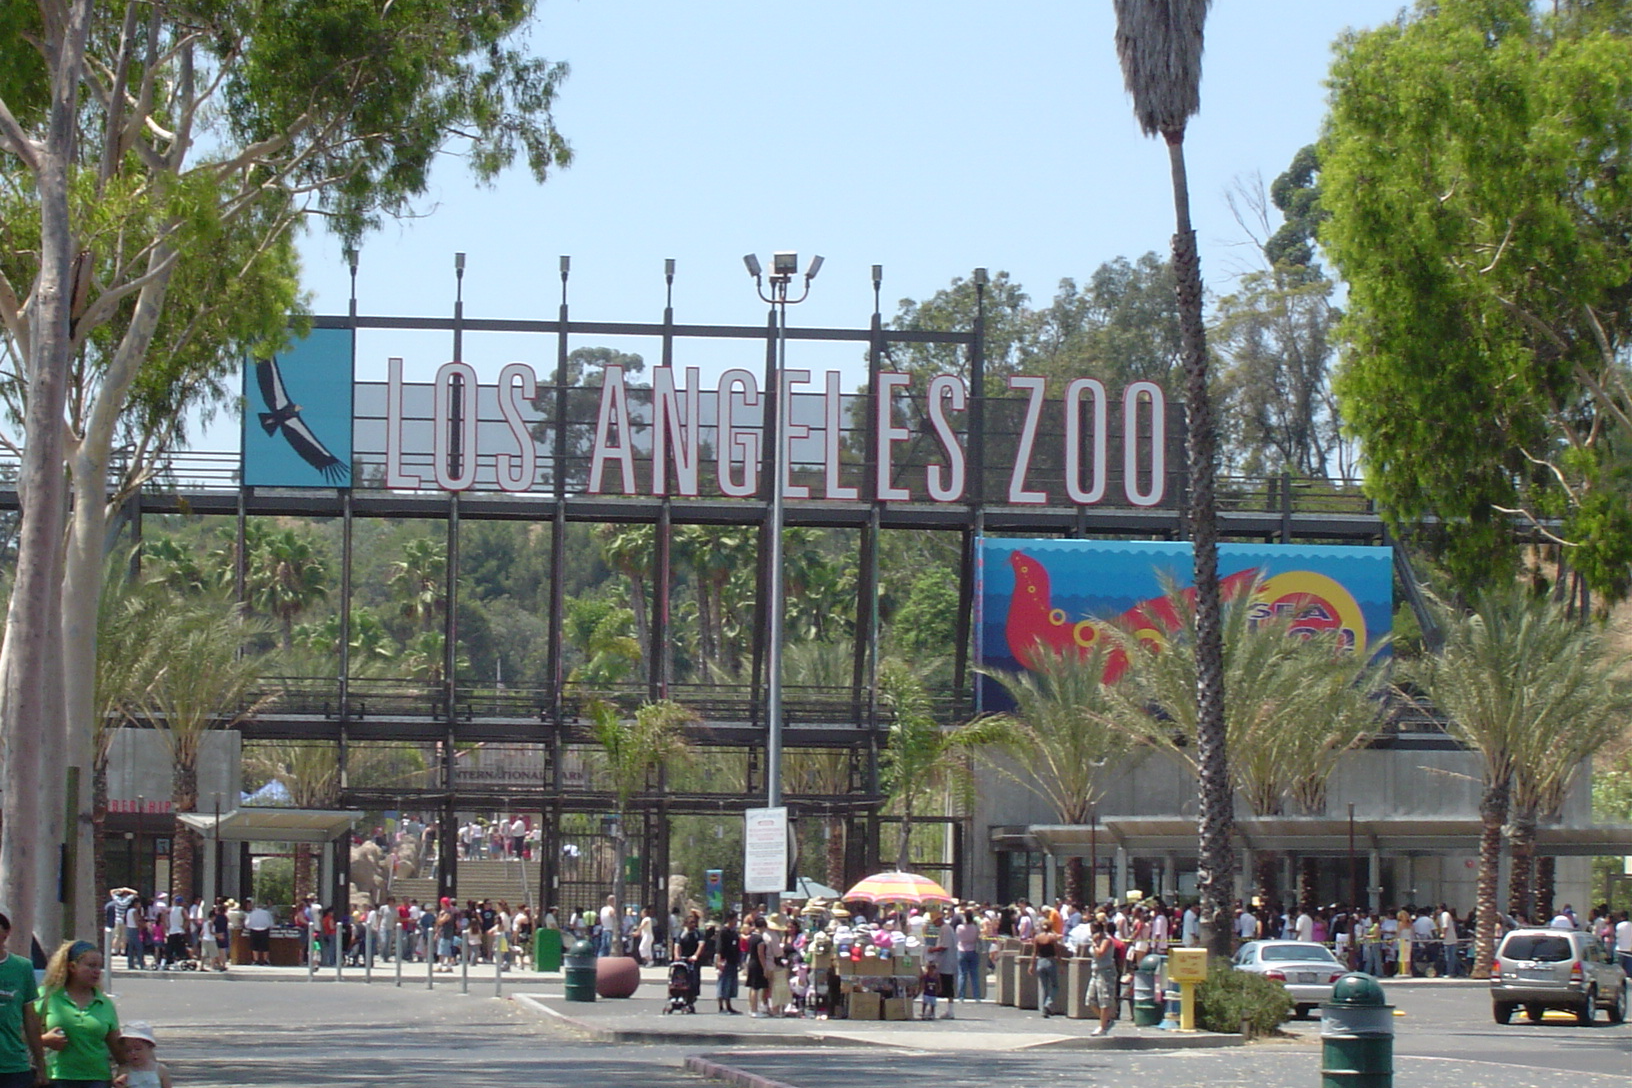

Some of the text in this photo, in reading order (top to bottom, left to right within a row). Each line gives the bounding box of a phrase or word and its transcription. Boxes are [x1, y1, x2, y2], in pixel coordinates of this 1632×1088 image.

[386, 357, 1167, 506] LOS ANGELES ZOO
[1247, 602, 1333, 621] SEA
[453, 770, 546, 780] NTERNTIONAL
